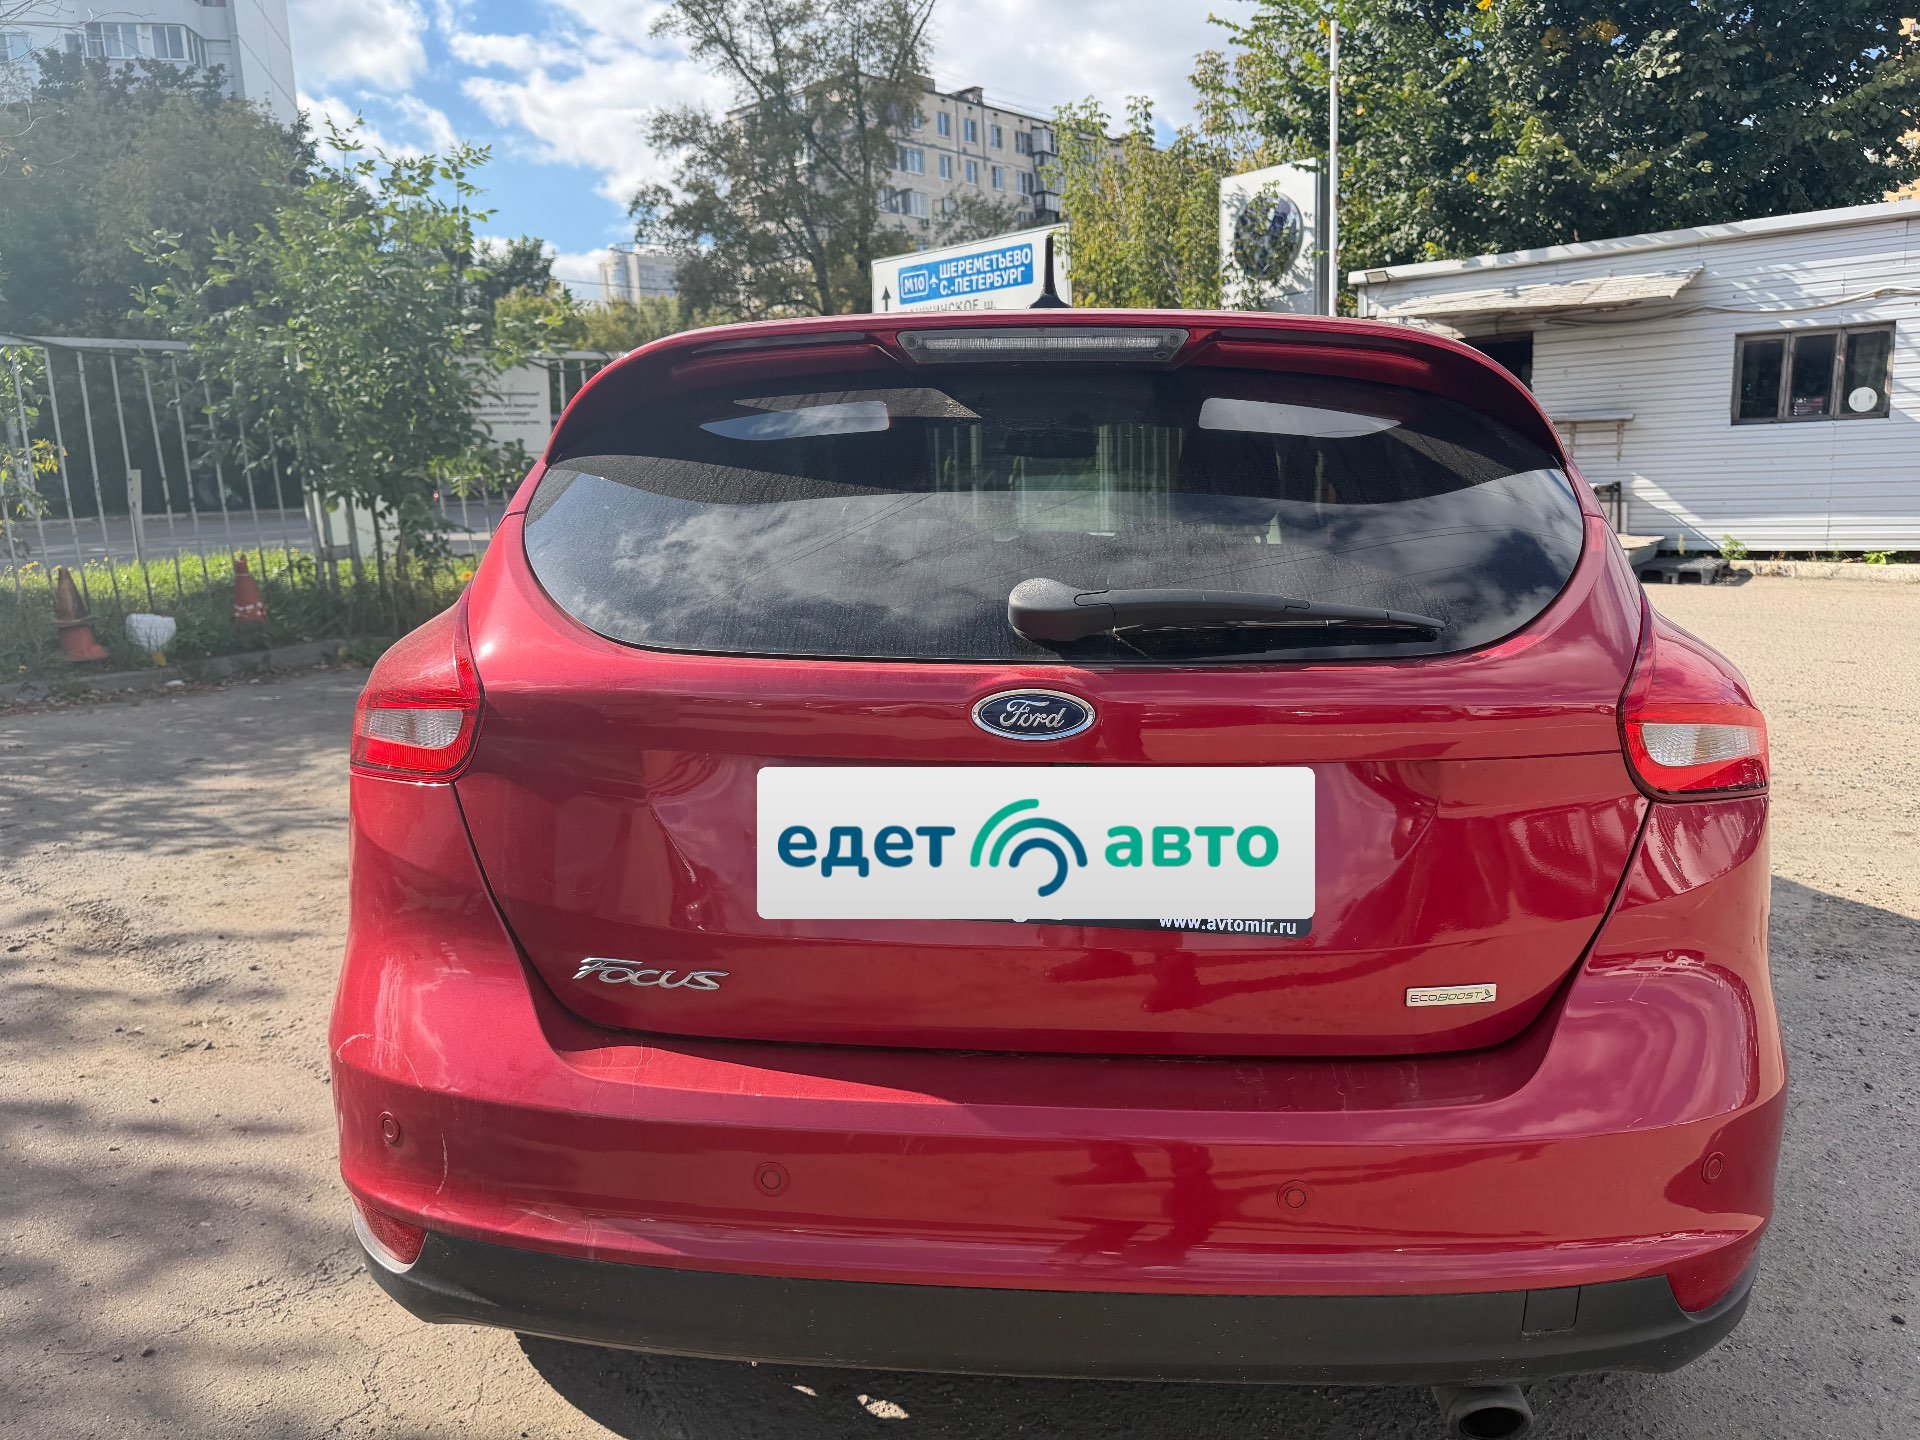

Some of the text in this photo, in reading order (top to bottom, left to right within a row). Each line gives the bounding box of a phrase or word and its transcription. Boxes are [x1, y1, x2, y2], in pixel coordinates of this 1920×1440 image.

[939, 248, 1032, 279] ШЕРЕМЕТЬЕВО
[903, 276, 926, 293] М10
[939, 267, 1025, 296] С.-ПЕТЕРБУРГ
[1000, 699, 1065, 728] Ford
[1159, 918, 1297, 935] www.avtomir.ru
[1410, 991, 1482, 1003] ECOBOOST
